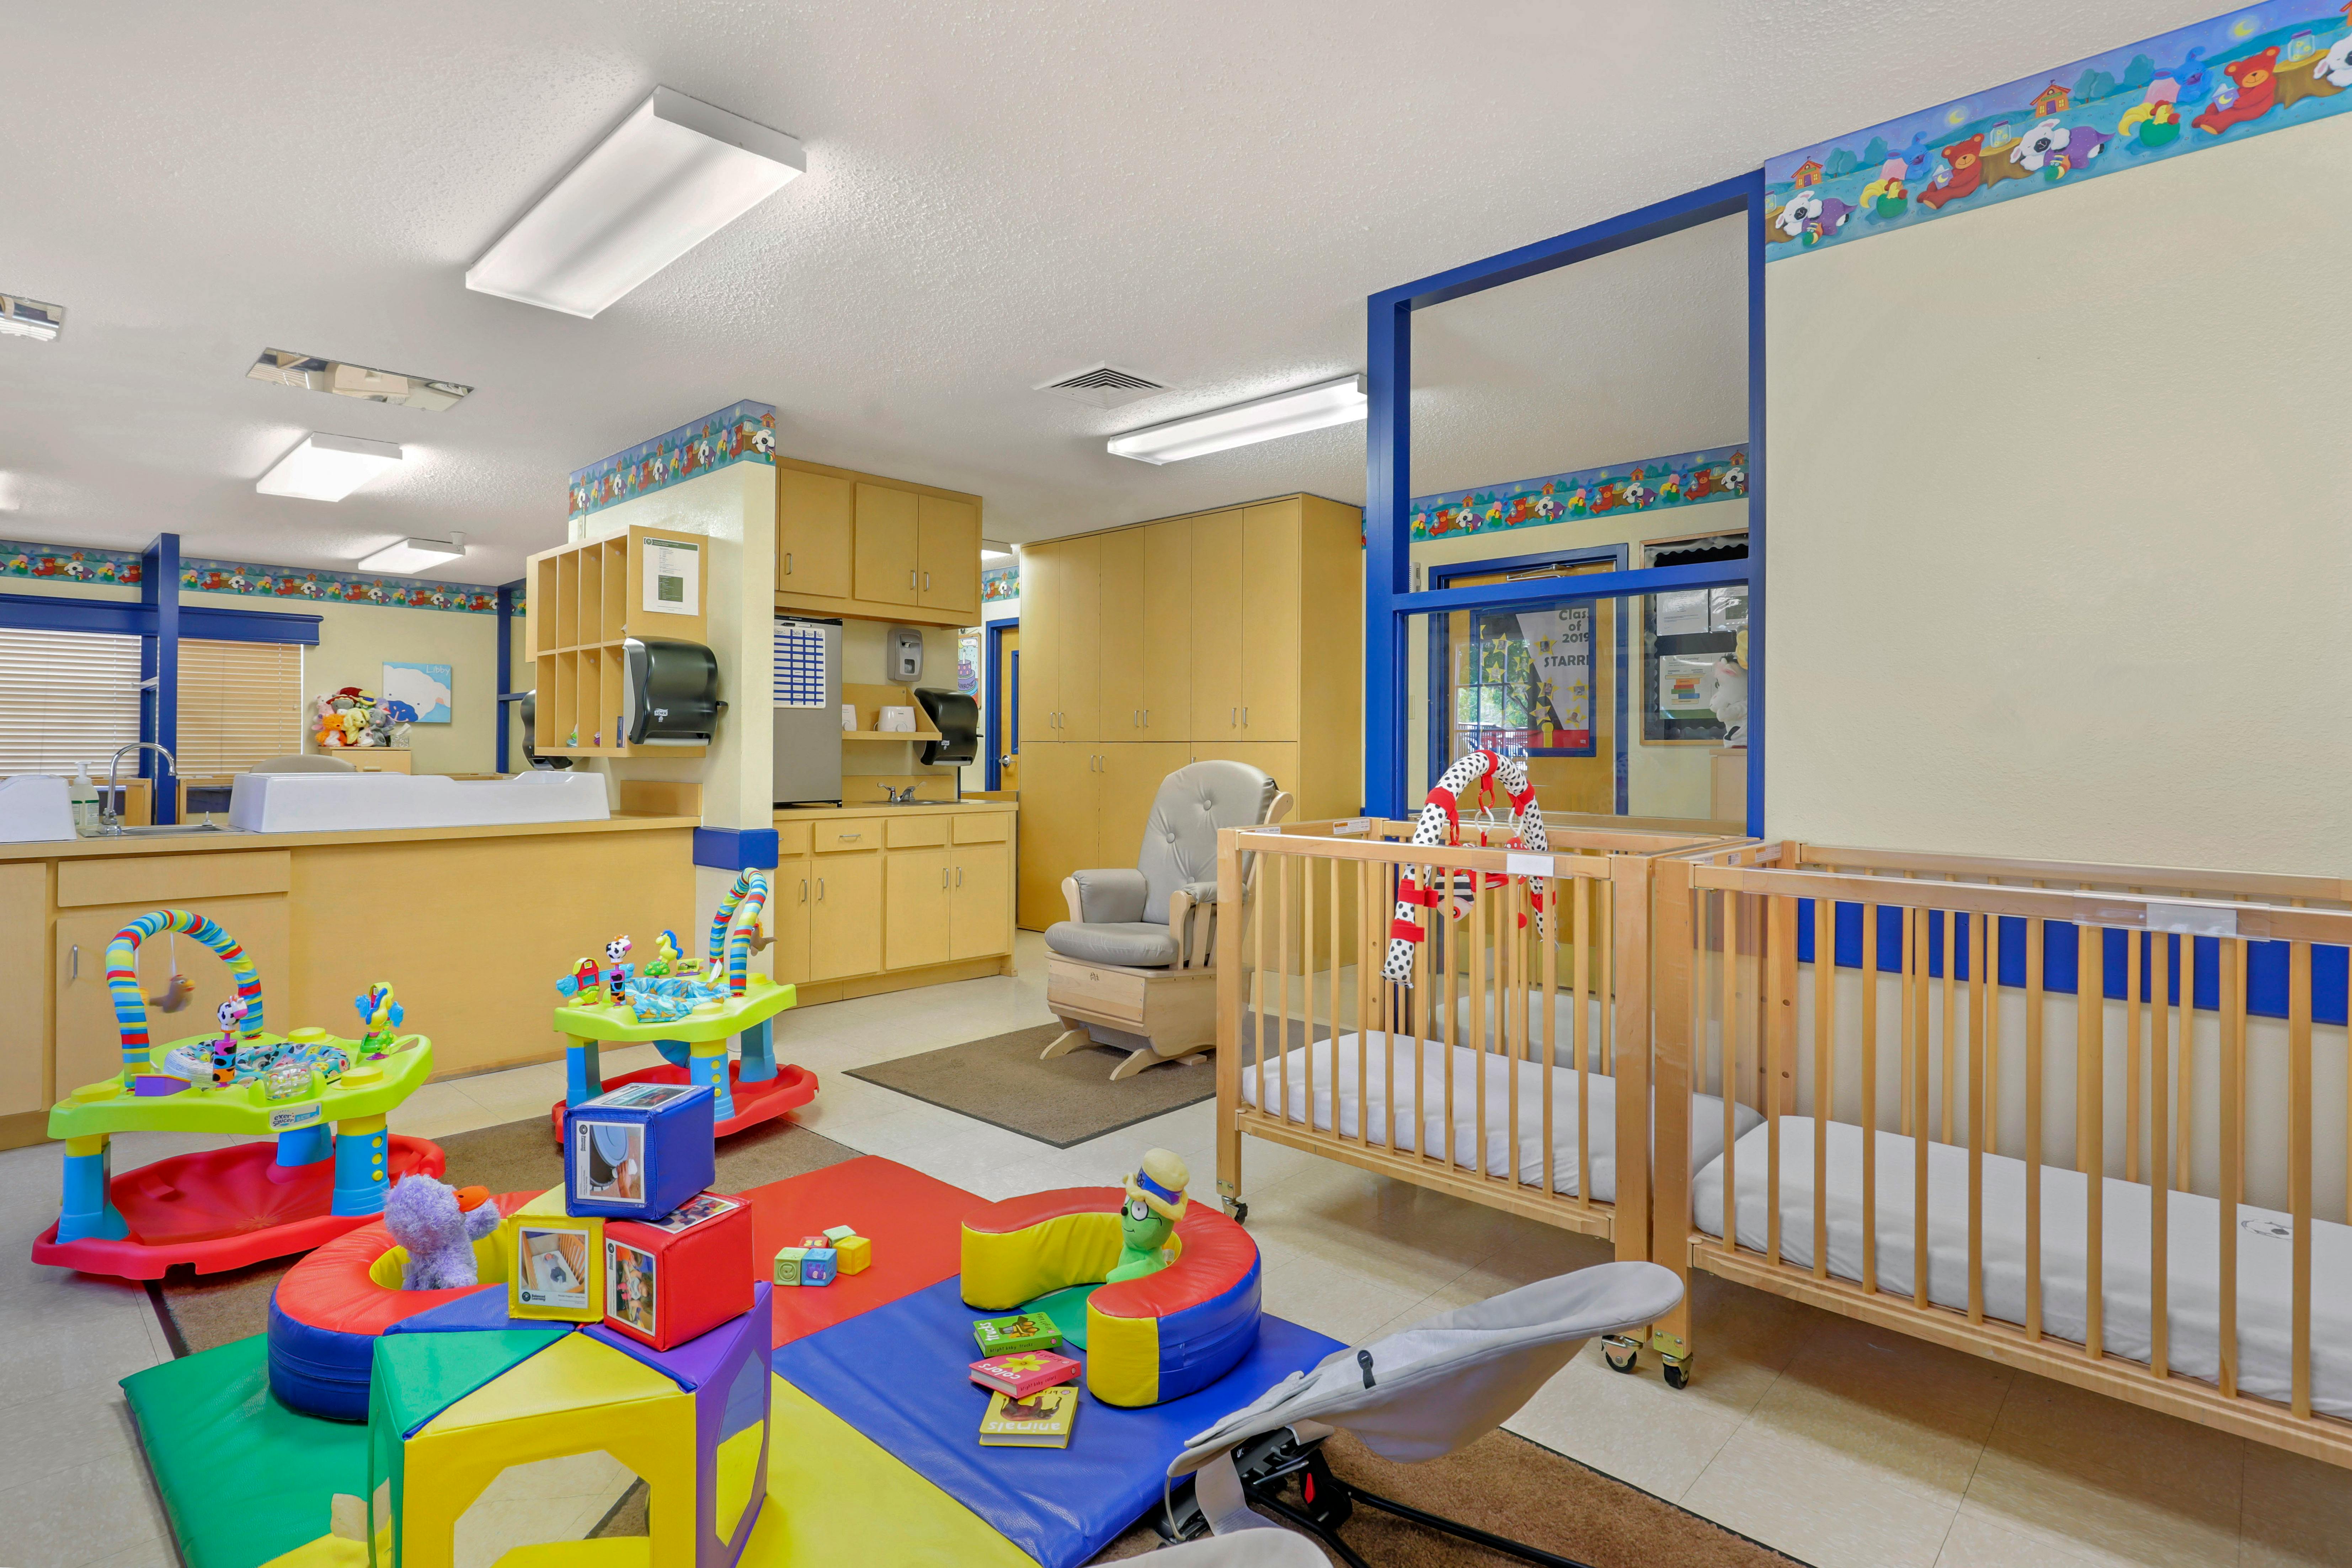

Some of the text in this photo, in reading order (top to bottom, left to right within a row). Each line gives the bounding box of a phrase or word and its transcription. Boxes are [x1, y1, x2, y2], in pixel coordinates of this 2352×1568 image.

[1559, 609, 1589, 620] Clas
[1569, 620, 1581, 631] of
[1562, 633, 1589, 642] 2019
[426, 665, 450, 676] Libby
[273, 1118, 294, 1126] saucer
[978, 1322, 999, 1341] trucks
[978, 1363, 1021, 1380] colors
[987, 1422, 1061, 1432] animals
